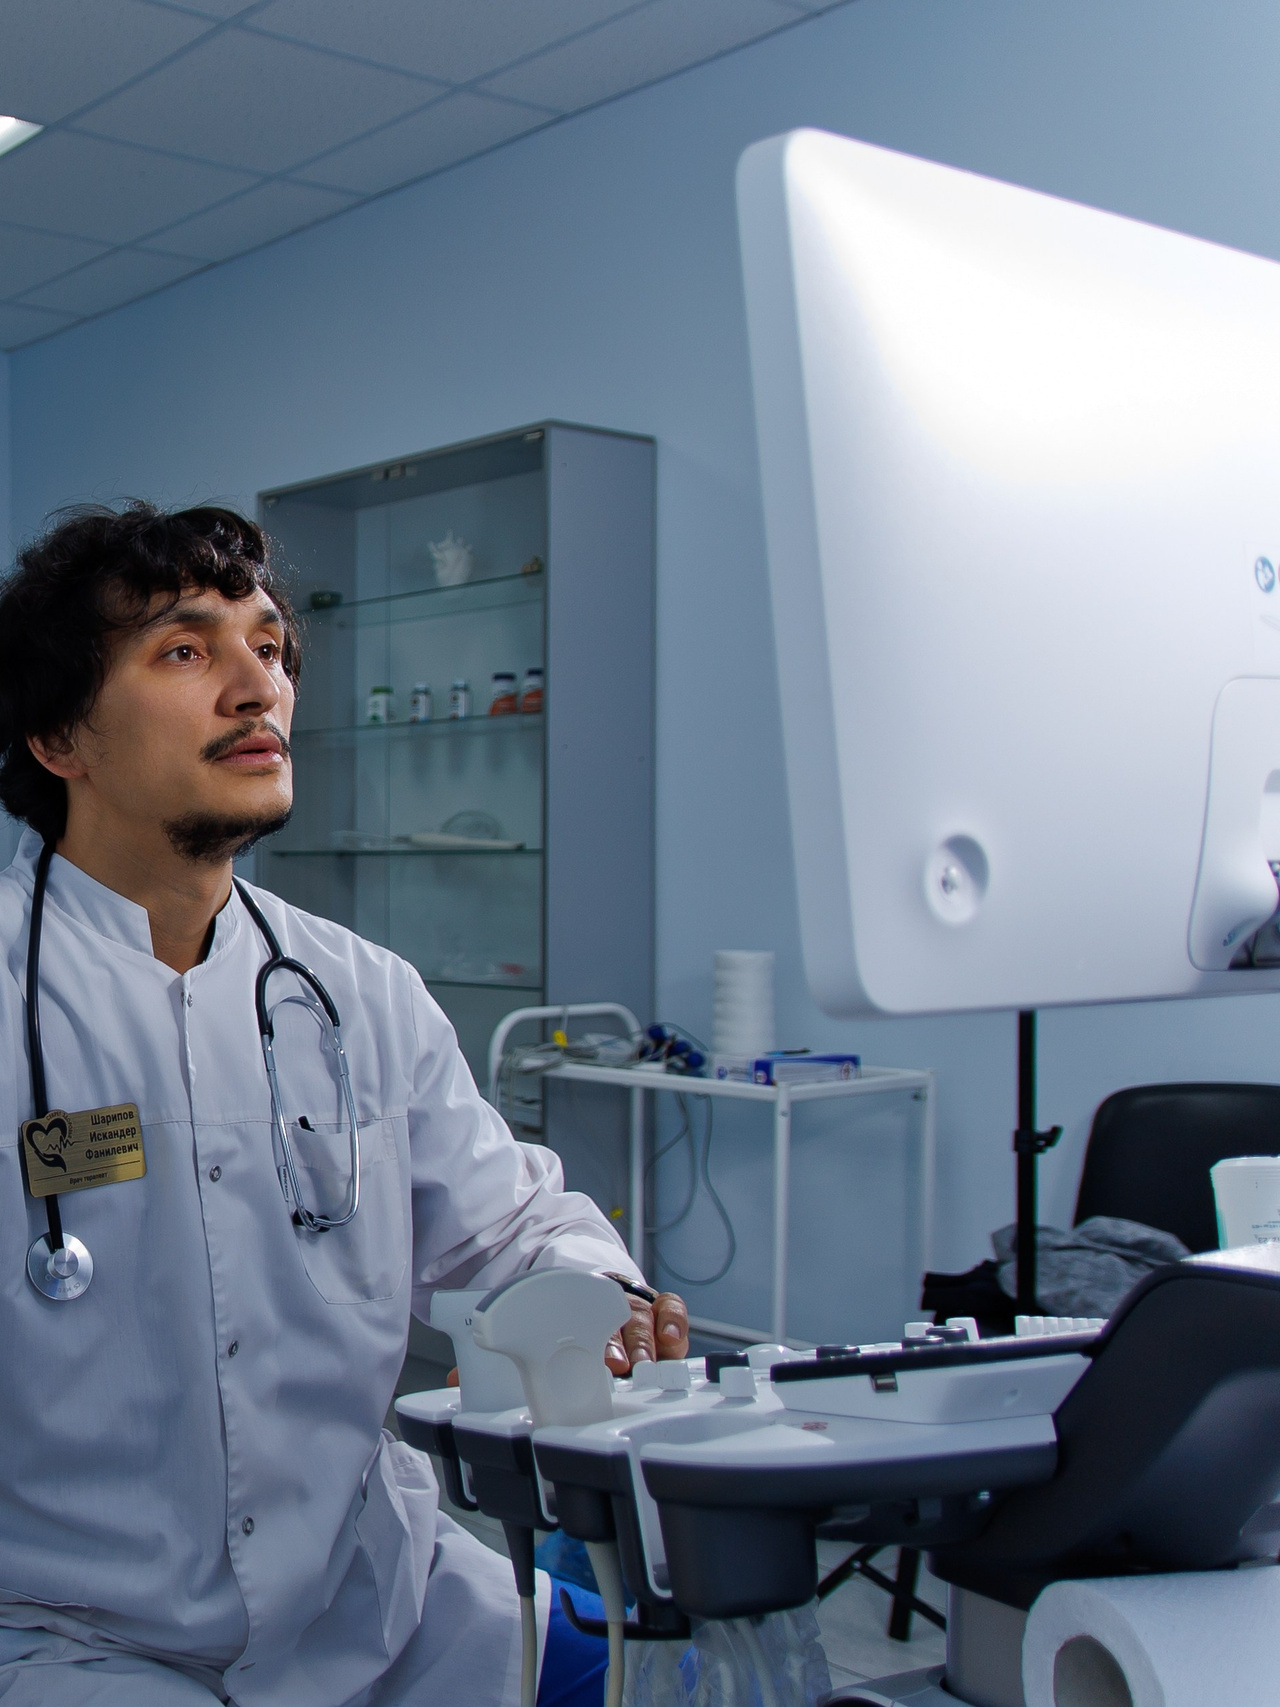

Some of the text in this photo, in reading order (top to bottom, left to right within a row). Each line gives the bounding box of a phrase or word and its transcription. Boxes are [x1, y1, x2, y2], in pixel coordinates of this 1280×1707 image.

[90, 1110, 134, 1126] Шарипов
[89, 1126, 137, 1143] Искандер
[85, 1142, 139, 1160] Фанилевич
